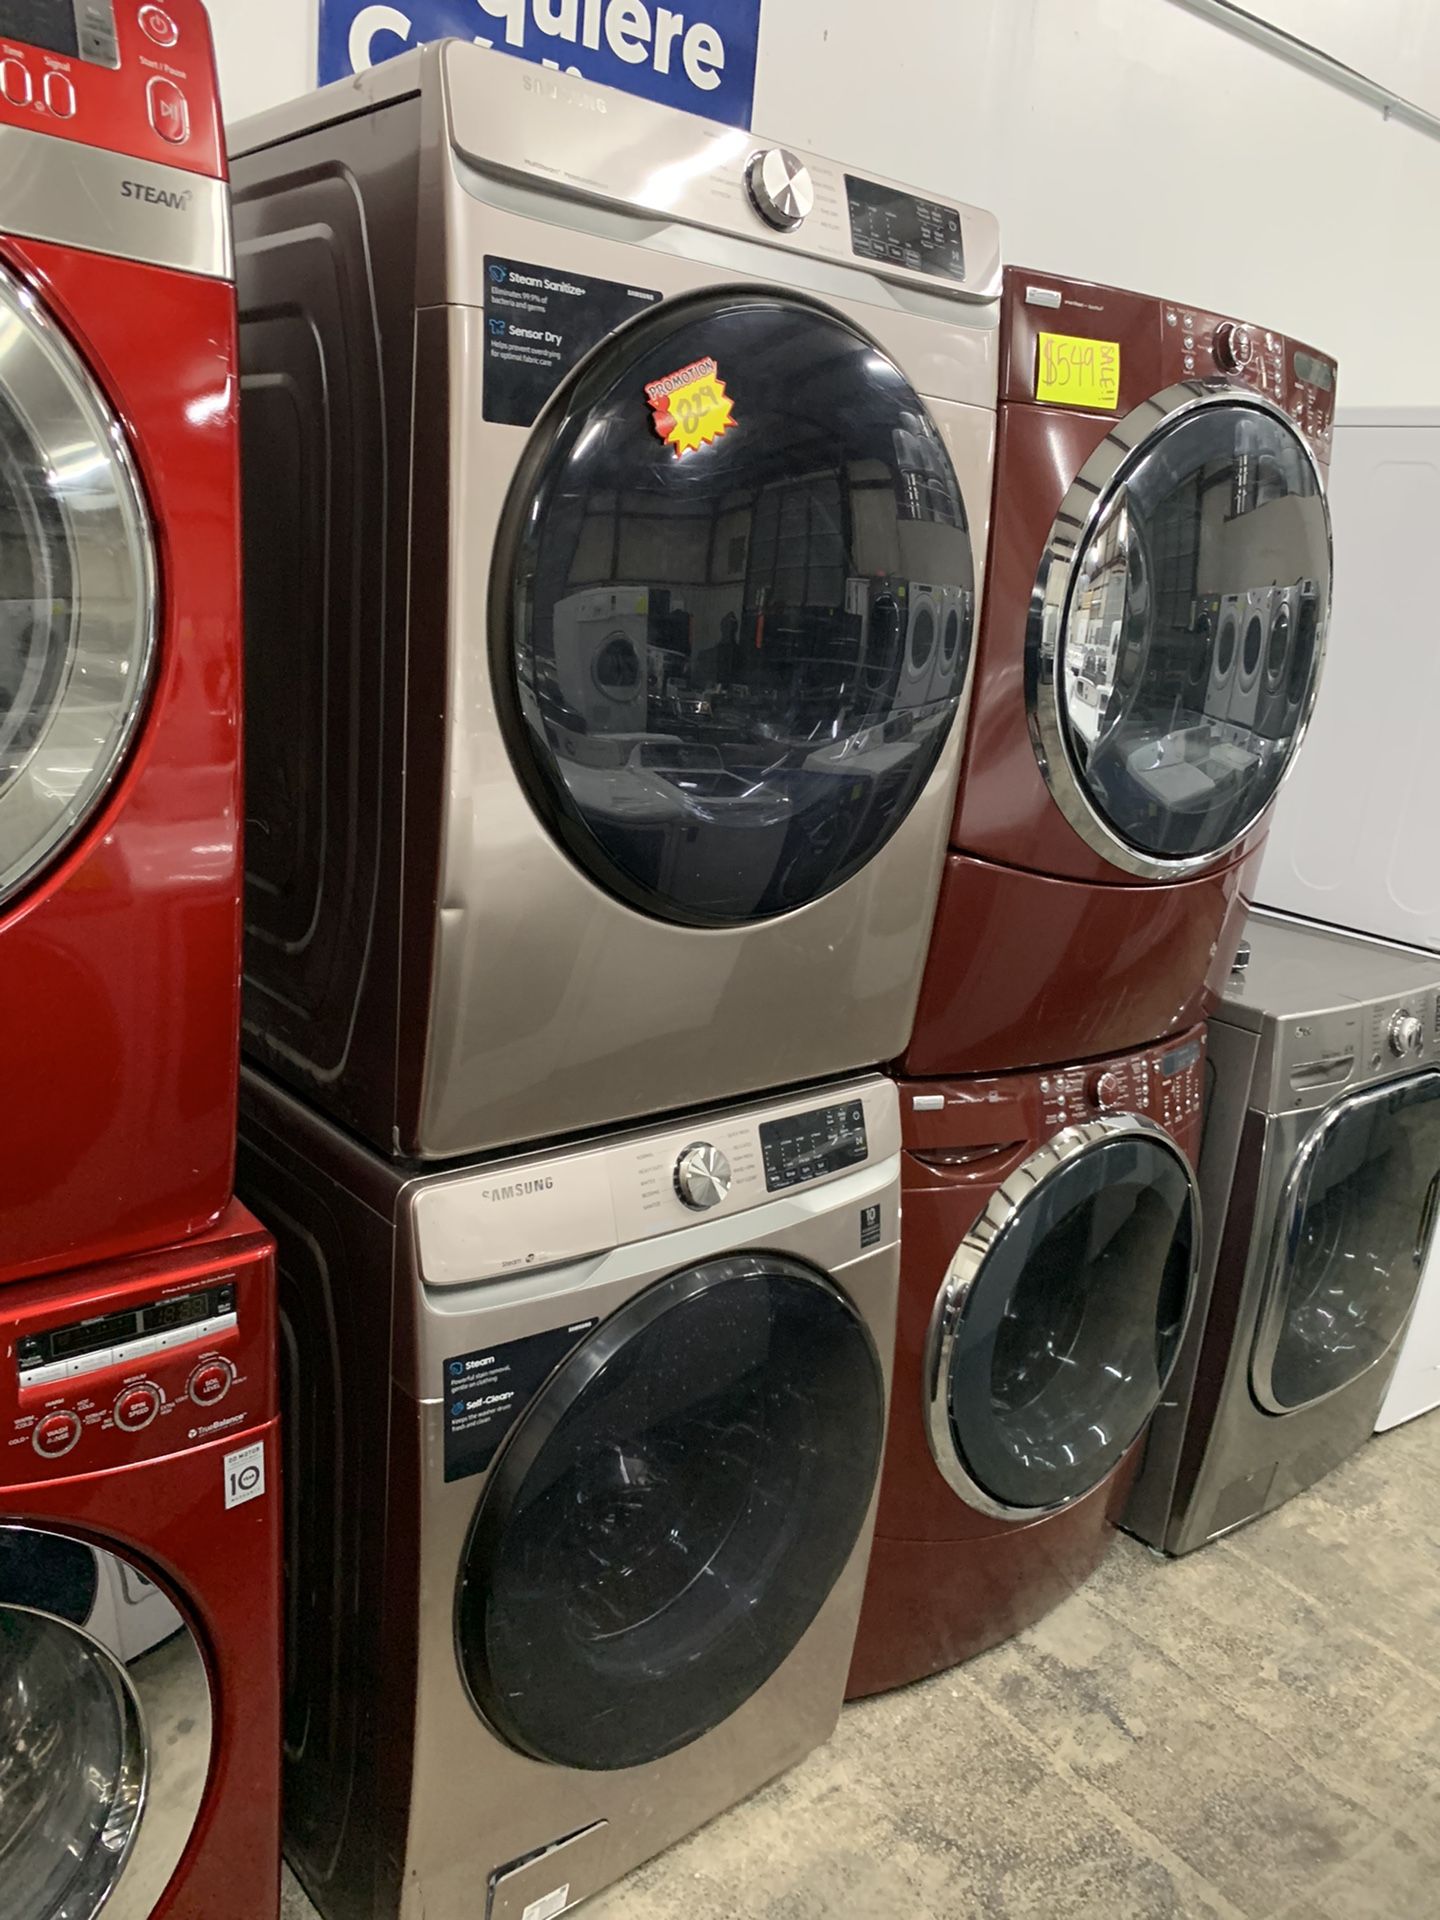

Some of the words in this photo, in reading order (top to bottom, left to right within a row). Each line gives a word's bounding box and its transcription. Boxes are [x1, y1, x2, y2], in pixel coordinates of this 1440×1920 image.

[522, 75, 608, 114] SANG
[120, 181, 187, 211] STEAM
[508, 271, 543, 288] Steam
[515, 301, 527, 309] and
[508, 324, 544, 340] Sensor
[544, 331, 562, 346] Dry
[1042, 338, 1095, 388] $549
[649, 359, 714, 399] PROMOTION
[481, 1176, 554, 1203] SAMSUNG
[865, 1207, 876, 1222] 10
[465, 1356, 496, 1370] Steam
[202, 1382, 221, 1394] LEVEL
[127, 1406, 150, 1418] SPEED
[130, 1401, 147, 1411] SPIN
[230, 1465, 260, 1496] 10
